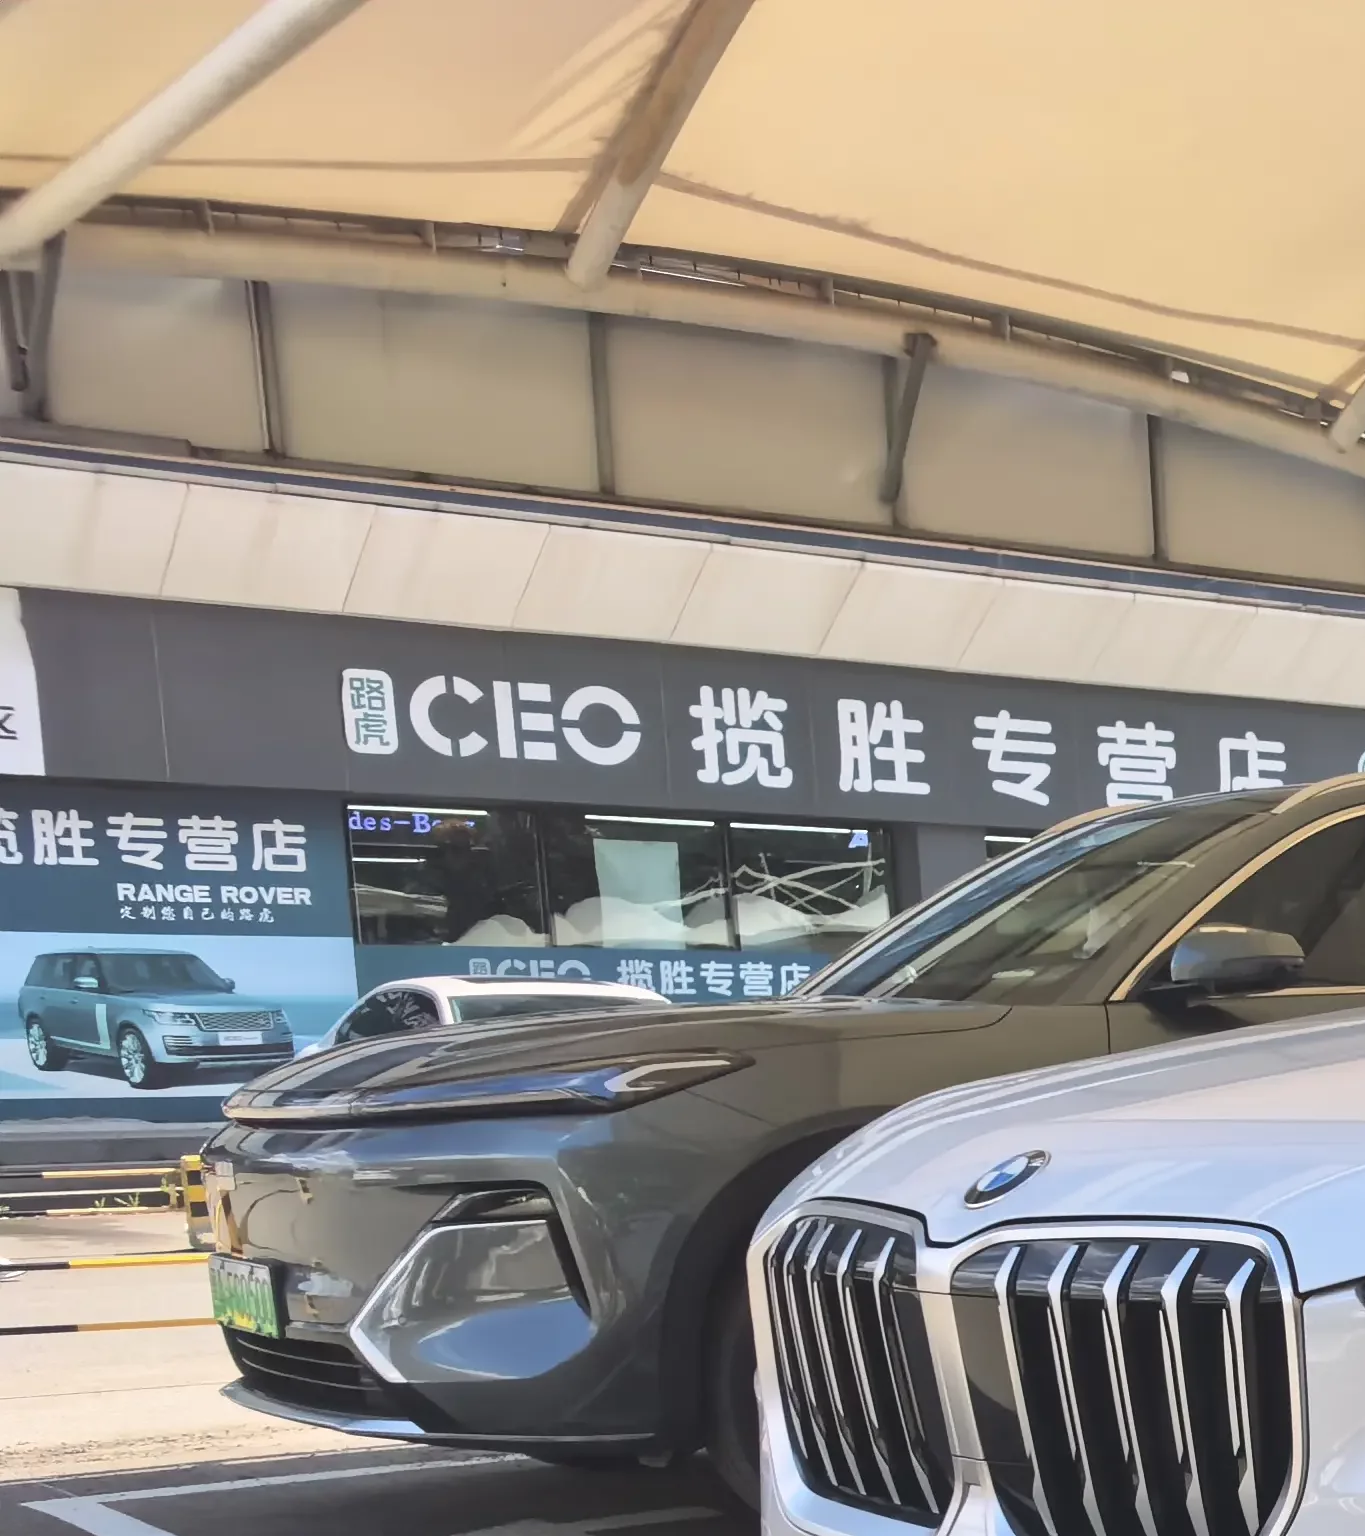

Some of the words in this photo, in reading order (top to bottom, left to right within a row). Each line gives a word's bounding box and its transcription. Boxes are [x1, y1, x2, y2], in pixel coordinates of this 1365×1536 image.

[409, 675, 642, 766] CEO
[689, 685, 1287, 808] 揽胜专营店
[116, 883, 212, 904] RANGE
[220, 885, 312, 906] ROVER
[119, 906, 275, 923] 定制您自己的路虎
